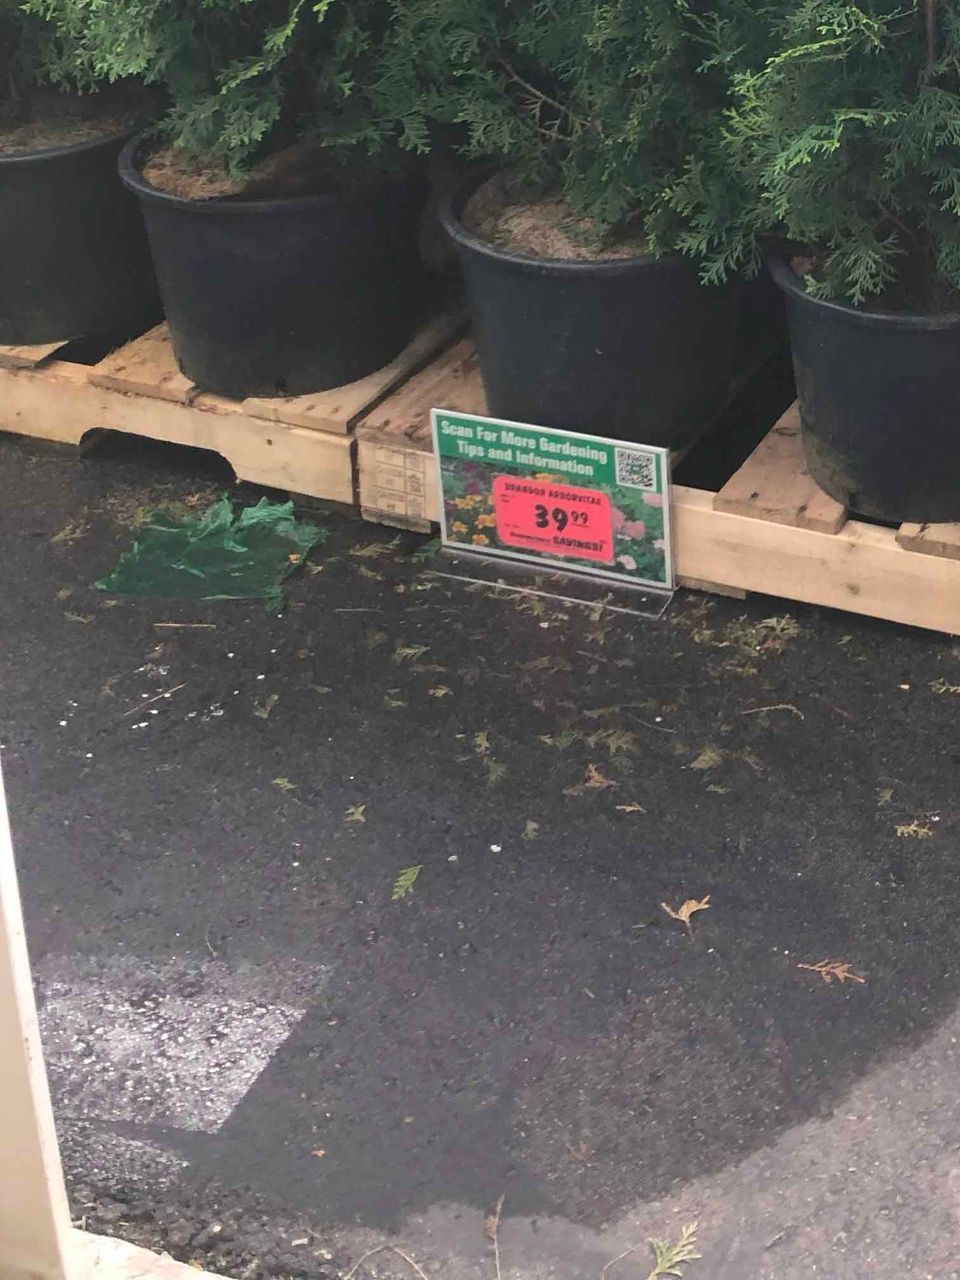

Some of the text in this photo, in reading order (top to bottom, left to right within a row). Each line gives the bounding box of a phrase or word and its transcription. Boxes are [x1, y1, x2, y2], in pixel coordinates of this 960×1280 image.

[441, 420, 607, 465] Scan For More Gardening
[457, 440, 594, 476] Tips and Information
